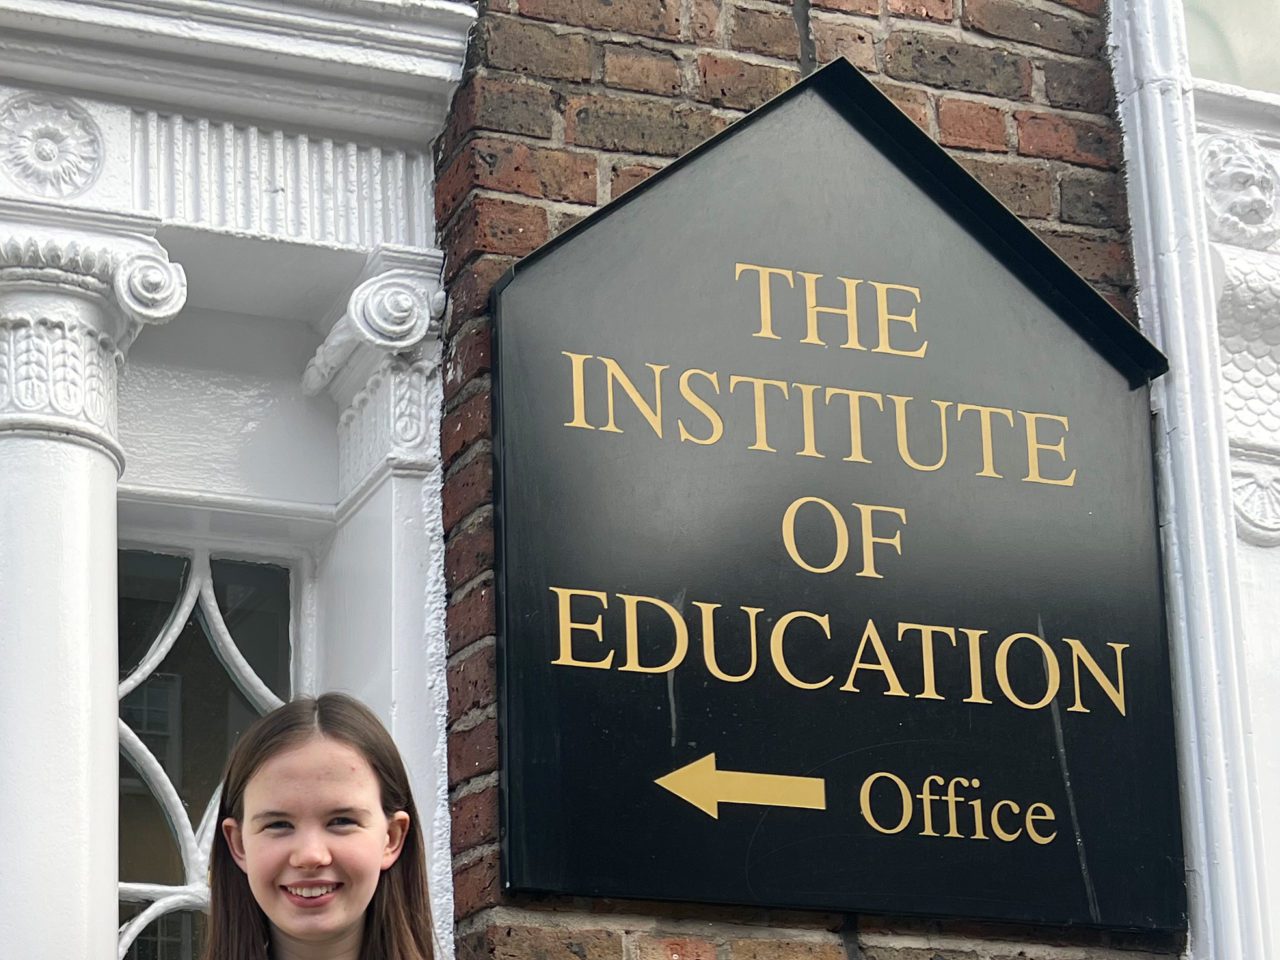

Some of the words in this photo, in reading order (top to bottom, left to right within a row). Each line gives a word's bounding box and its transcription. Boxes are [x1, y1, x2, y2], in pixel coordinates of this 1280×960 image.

[734, 261, 929, 359] THE
[561, 350, 1078, 487] INSTITUTE
[781, 495, 908, 579] OF
[549, 586, 1131, 716] EDUCATION
[858, 771, 1058, 846] Office
